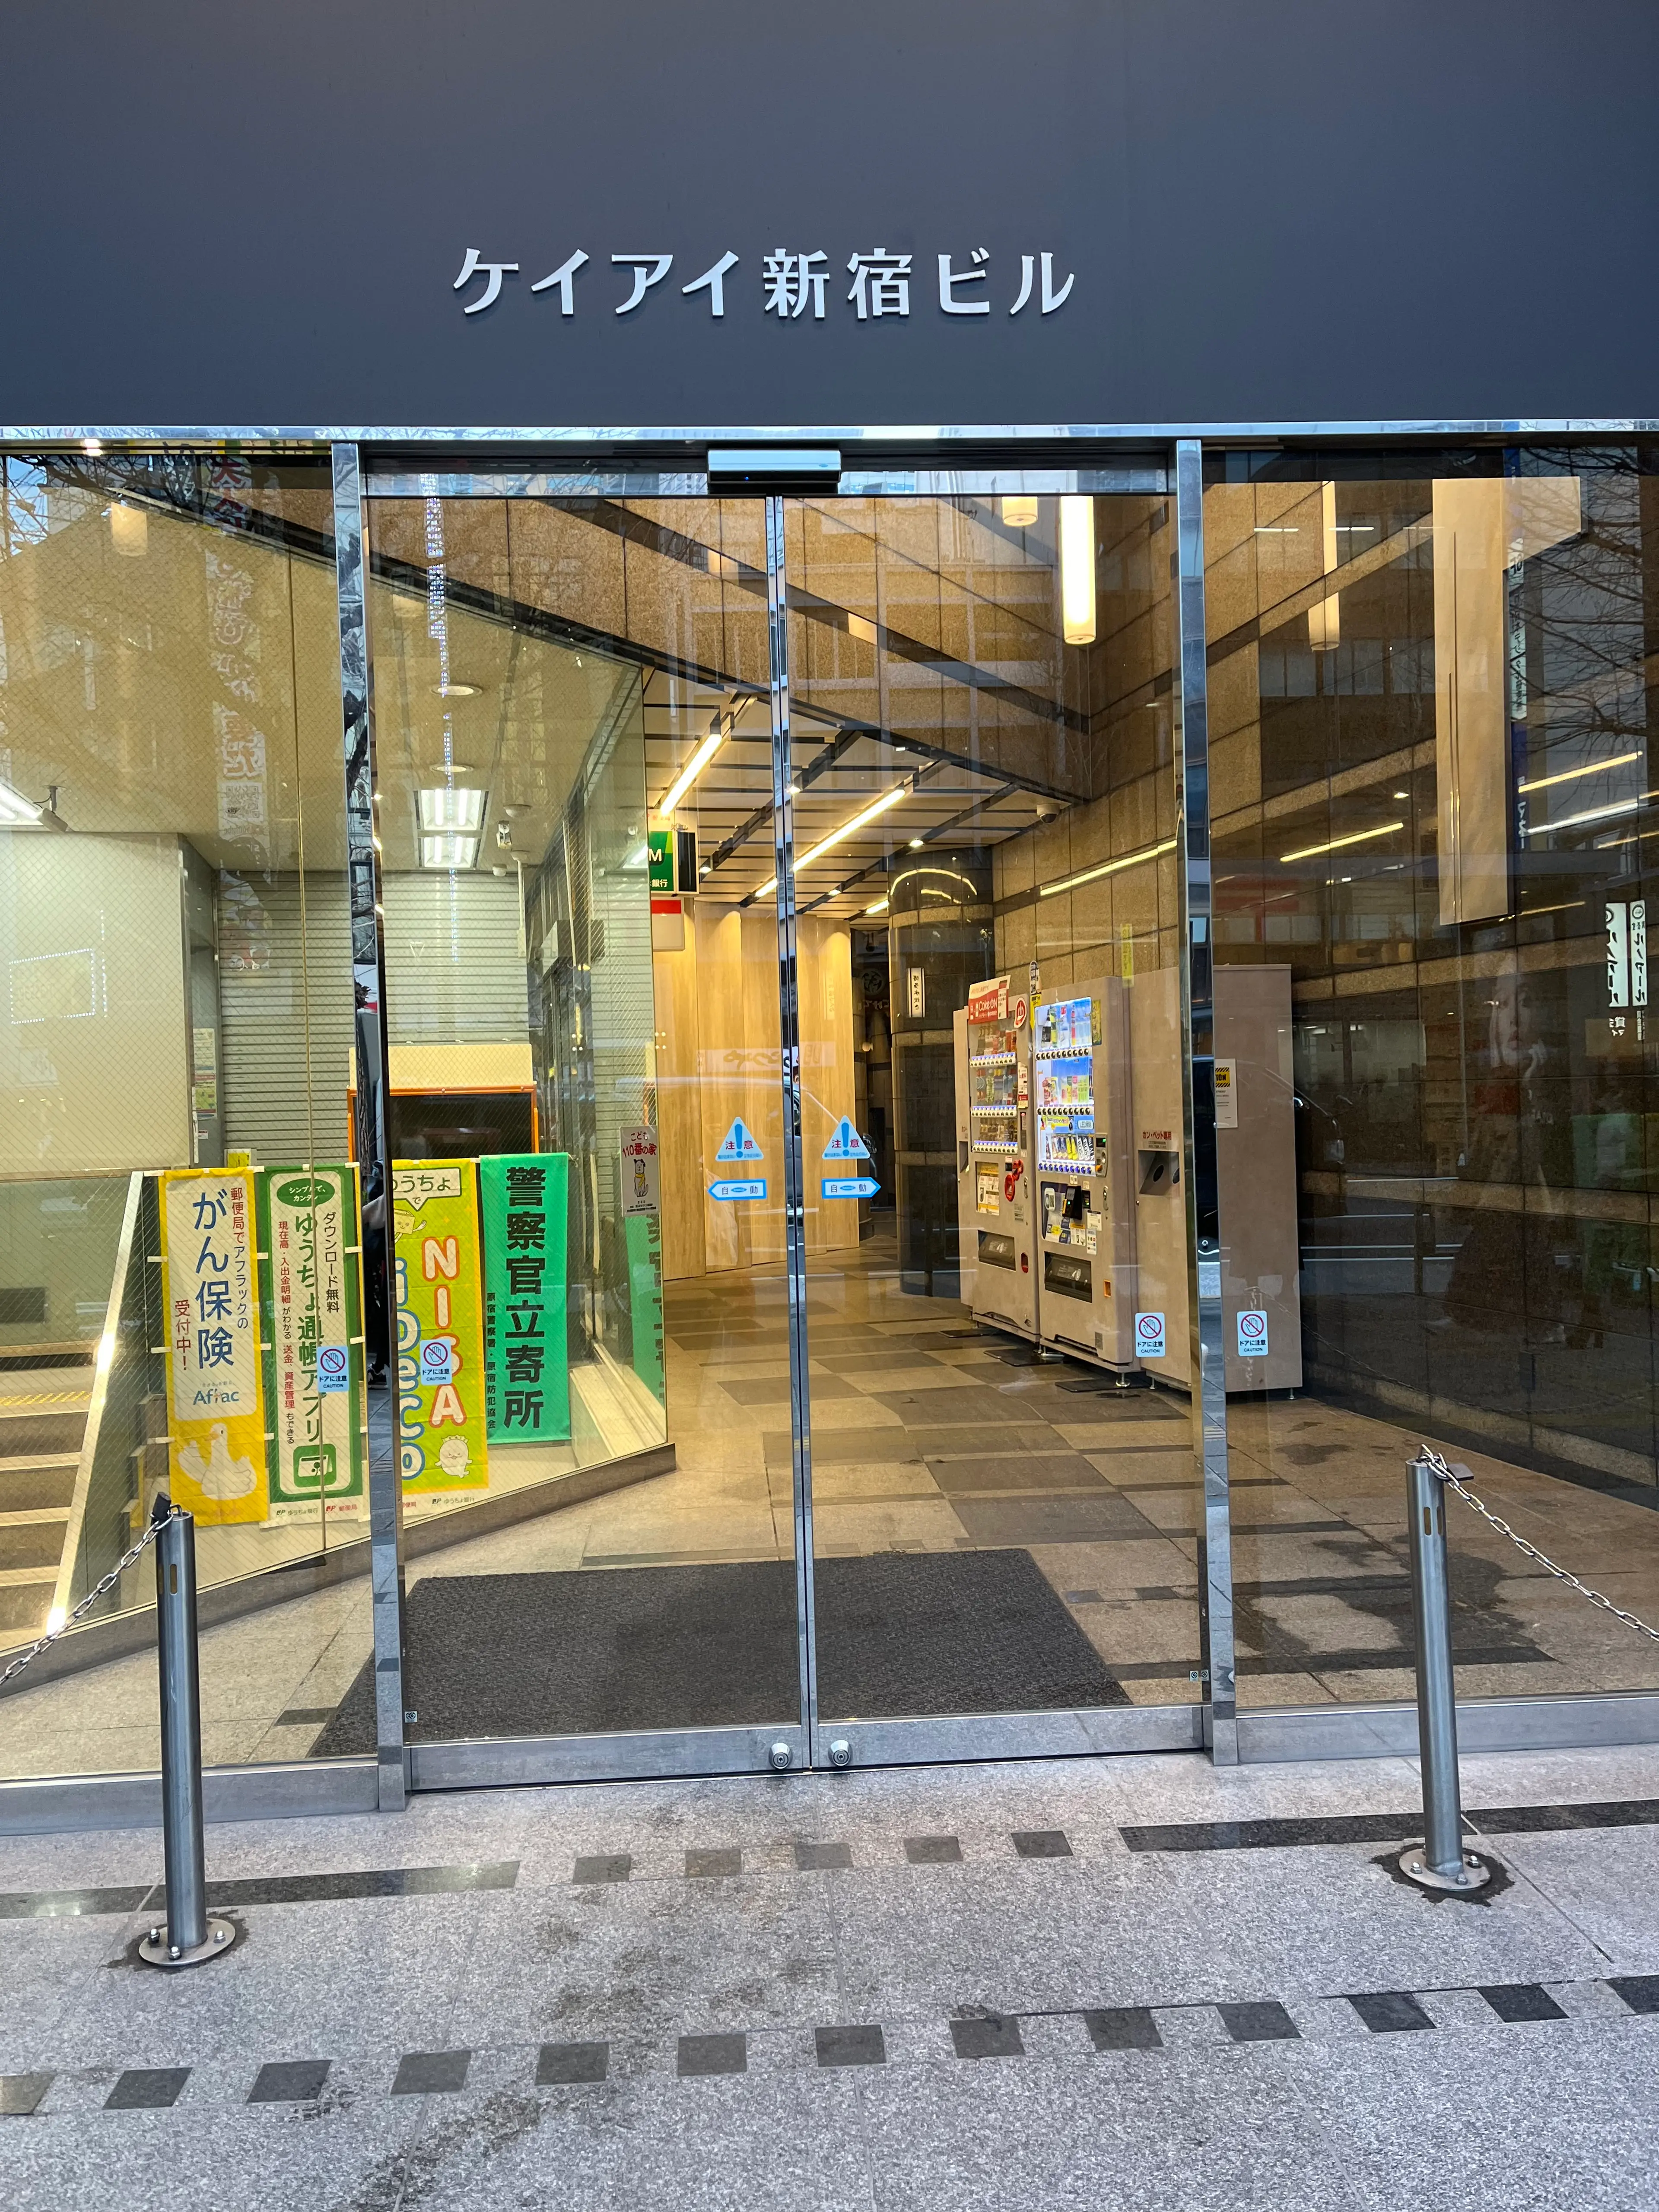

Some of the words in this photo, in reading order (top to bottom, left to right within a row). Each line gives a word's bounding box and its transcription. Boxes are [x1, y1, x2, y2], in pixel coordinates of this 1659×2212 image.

[453, 247, 1075, 320] ケイアイ新宿ビル
[623, 1143, 657, 1158] 110番の家
[631, 1131, 648, 1141] こども
[725, 1140, 753, 1150] 注意
[832, 1139, 860, 1148] 注意
[192, 1189, 234, 1369] がん保険
[230, 1187, 248, 1329] 郵便局でアフラックの
[324, 1211, 340, 1314] ダウンロード無料
[504, 1167, 546, 1428] 警察官立寄所
[175, 1299, 191, 1370] 受付中！
[487, 1292, 496, 1429] 原宿警察署・原宿防犯協会
[193, 1389, 239, 1405] Aflac
